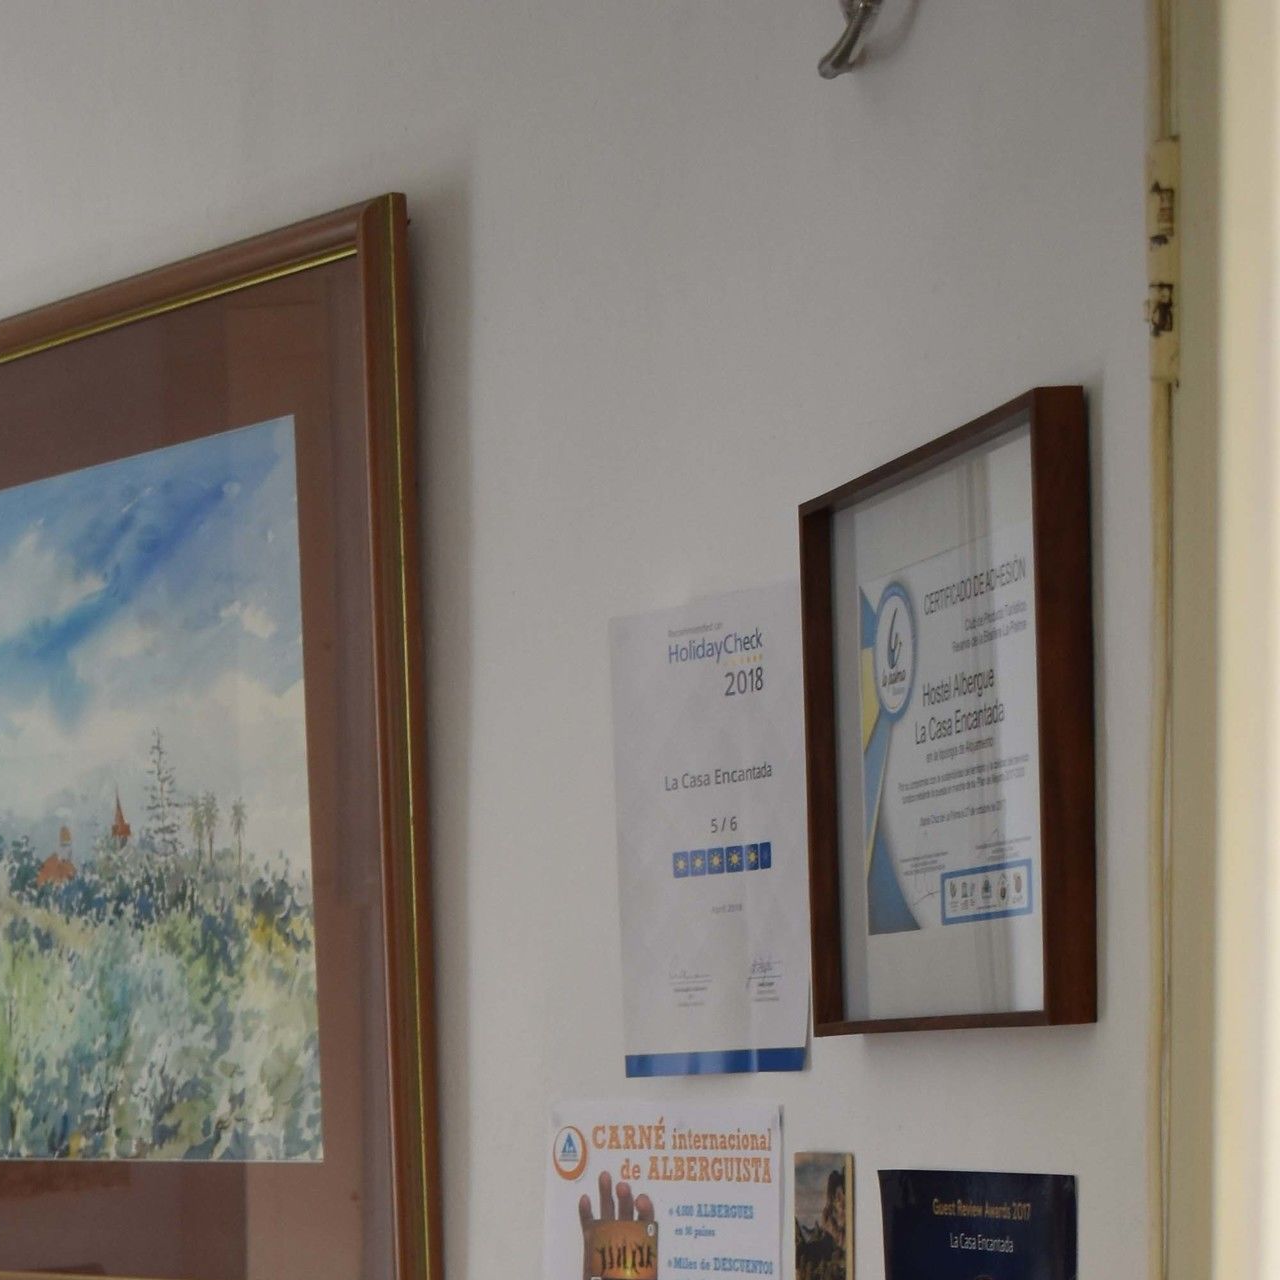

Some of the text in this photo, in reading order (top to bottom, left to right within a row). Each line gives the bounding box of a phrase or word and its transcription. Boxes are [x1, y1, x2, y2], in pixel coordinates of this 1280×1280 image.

[668, 627, 763, 664] HolidayCheck
[724, 666, 763, 696] 2018
[923, 668, 995, 706] Hostel Albergue
[915, 699, 1004, 745] La Casa Encantada
[665, 761, 773, 791] La Casa Encantada
[711, 818, 718, 833] 5
[730, 816, 738, 831] 6
[592, 1117, 772, 1151] CARNÉ internacional
[621, 1156, 772, 1183] de ALBERGUISTA
[696, 1203, 754, 1219] ALBERGUES
[933, 1198, 1031, 1220] Guest Review Awards 2017
[950, 1232, 1014, 1253] La Casa Encantada
[673, 1257, 773, 1275] Miles de DESCUENTOS
